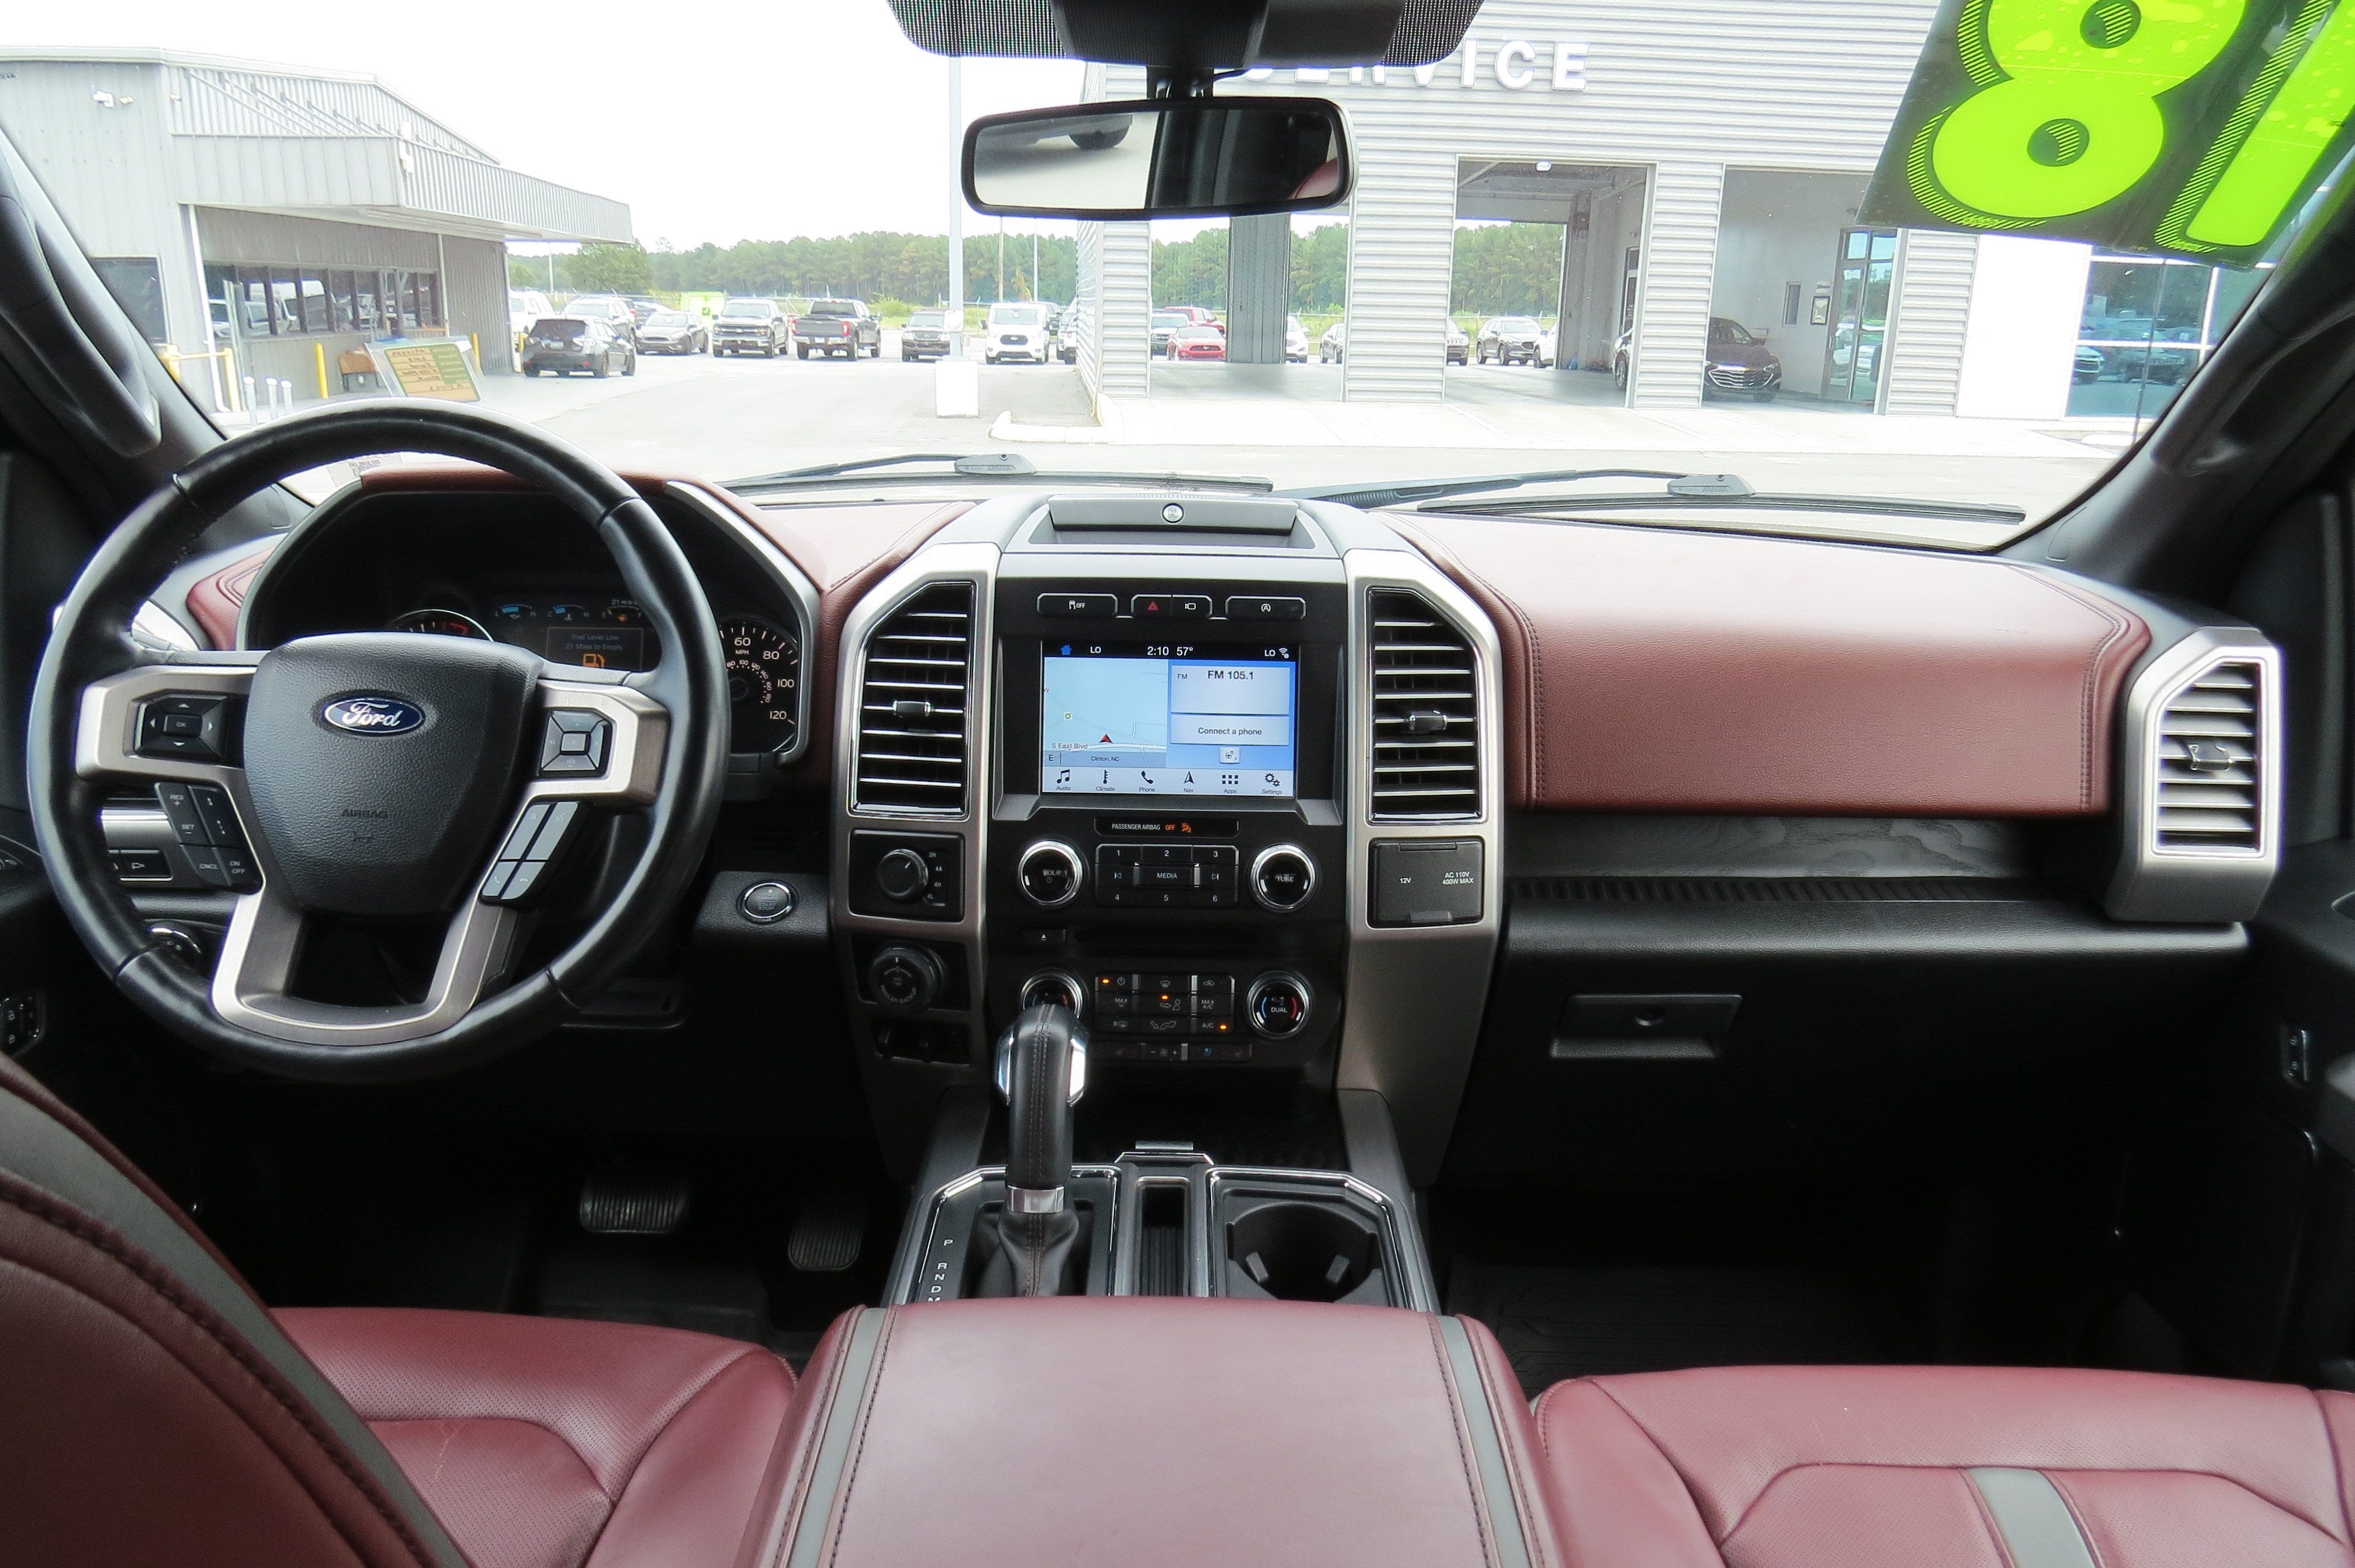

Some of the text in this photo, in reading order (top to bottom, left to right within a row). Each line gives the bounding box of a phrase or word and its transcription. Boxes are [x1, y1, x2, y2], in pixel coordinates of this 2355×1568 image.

[734, 637, 751, 646] 60
[763, 651, 780, 660] 80
[1147, 646, 1169, 656] 2:10
[751, 662, 761, 670] 120
[1208, 670, 1254, 680] FM 105.1
[777, 679, 795, 687] 100
[342, 702, 403, 727] Ford
[769, 711, 787, 719] 120
[1198, 727, 1230, 735] Connect
[1238, 727, 1262, 738] phone
